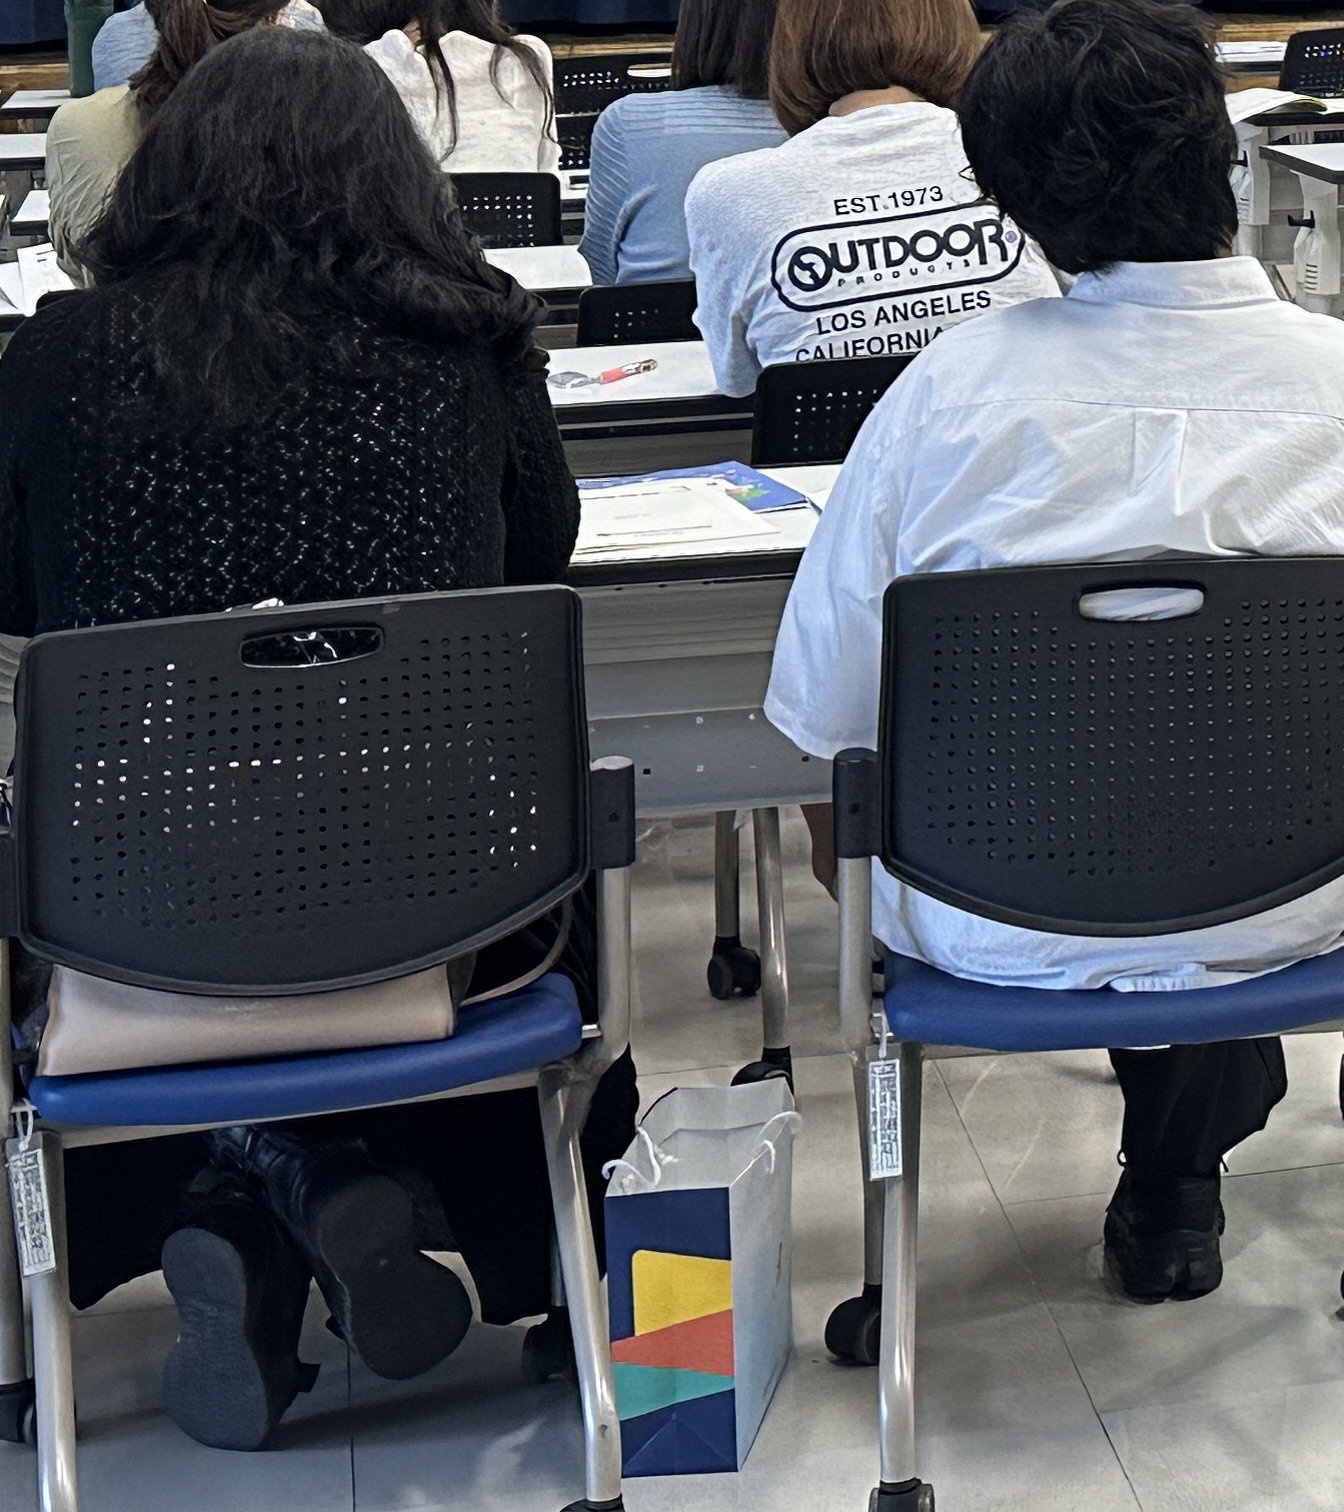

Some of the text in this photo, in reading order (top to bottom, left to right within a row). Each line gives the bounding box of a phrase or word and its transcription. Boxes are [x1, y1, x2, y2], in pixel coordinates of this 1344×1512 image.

[787, 218, 1009, 293] OUTDOOR
[815, 289, 992, 337] LOS ANGELES
